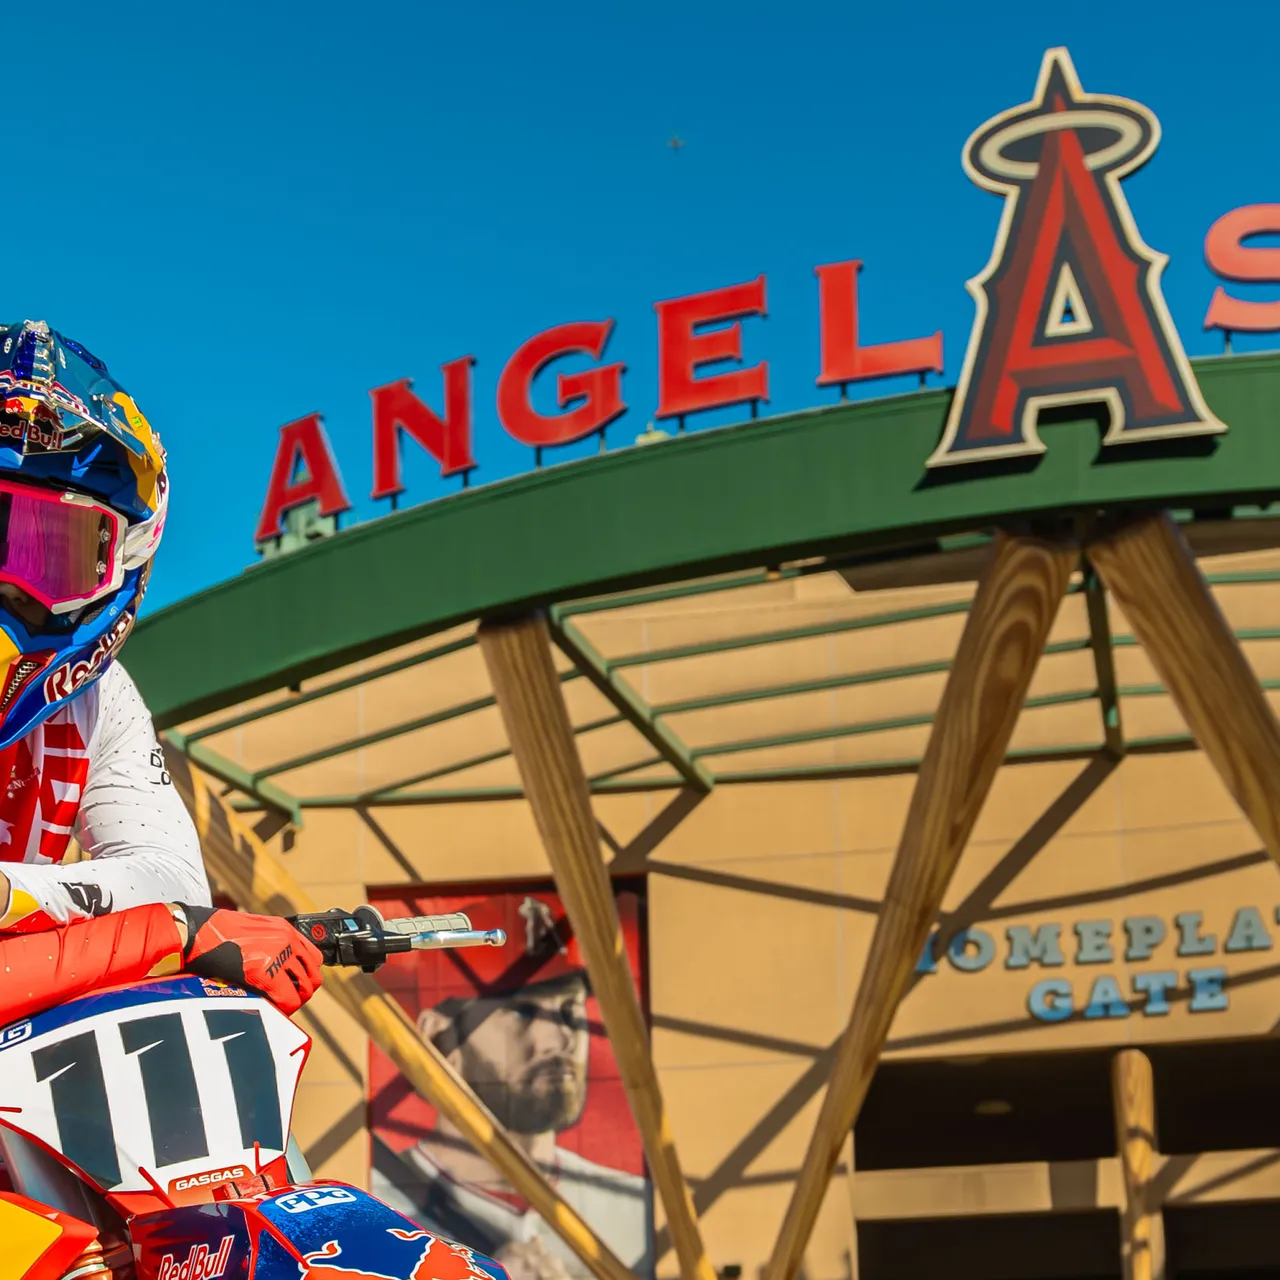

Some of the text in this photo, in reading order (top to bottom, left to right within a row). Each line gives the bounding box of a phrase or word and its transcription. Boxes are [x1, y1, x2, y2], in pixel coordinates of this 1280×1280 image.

[255, 259, 944, 544] ANGEL
[27, 425, 65, 450] Bull
[1027, 967, 1230, 1022] GATE
[30, 1009, 284, 1192] 111
[175, 1168, 245, 1192] GASGAS
[280, 1186, 355, 1211] PPG
